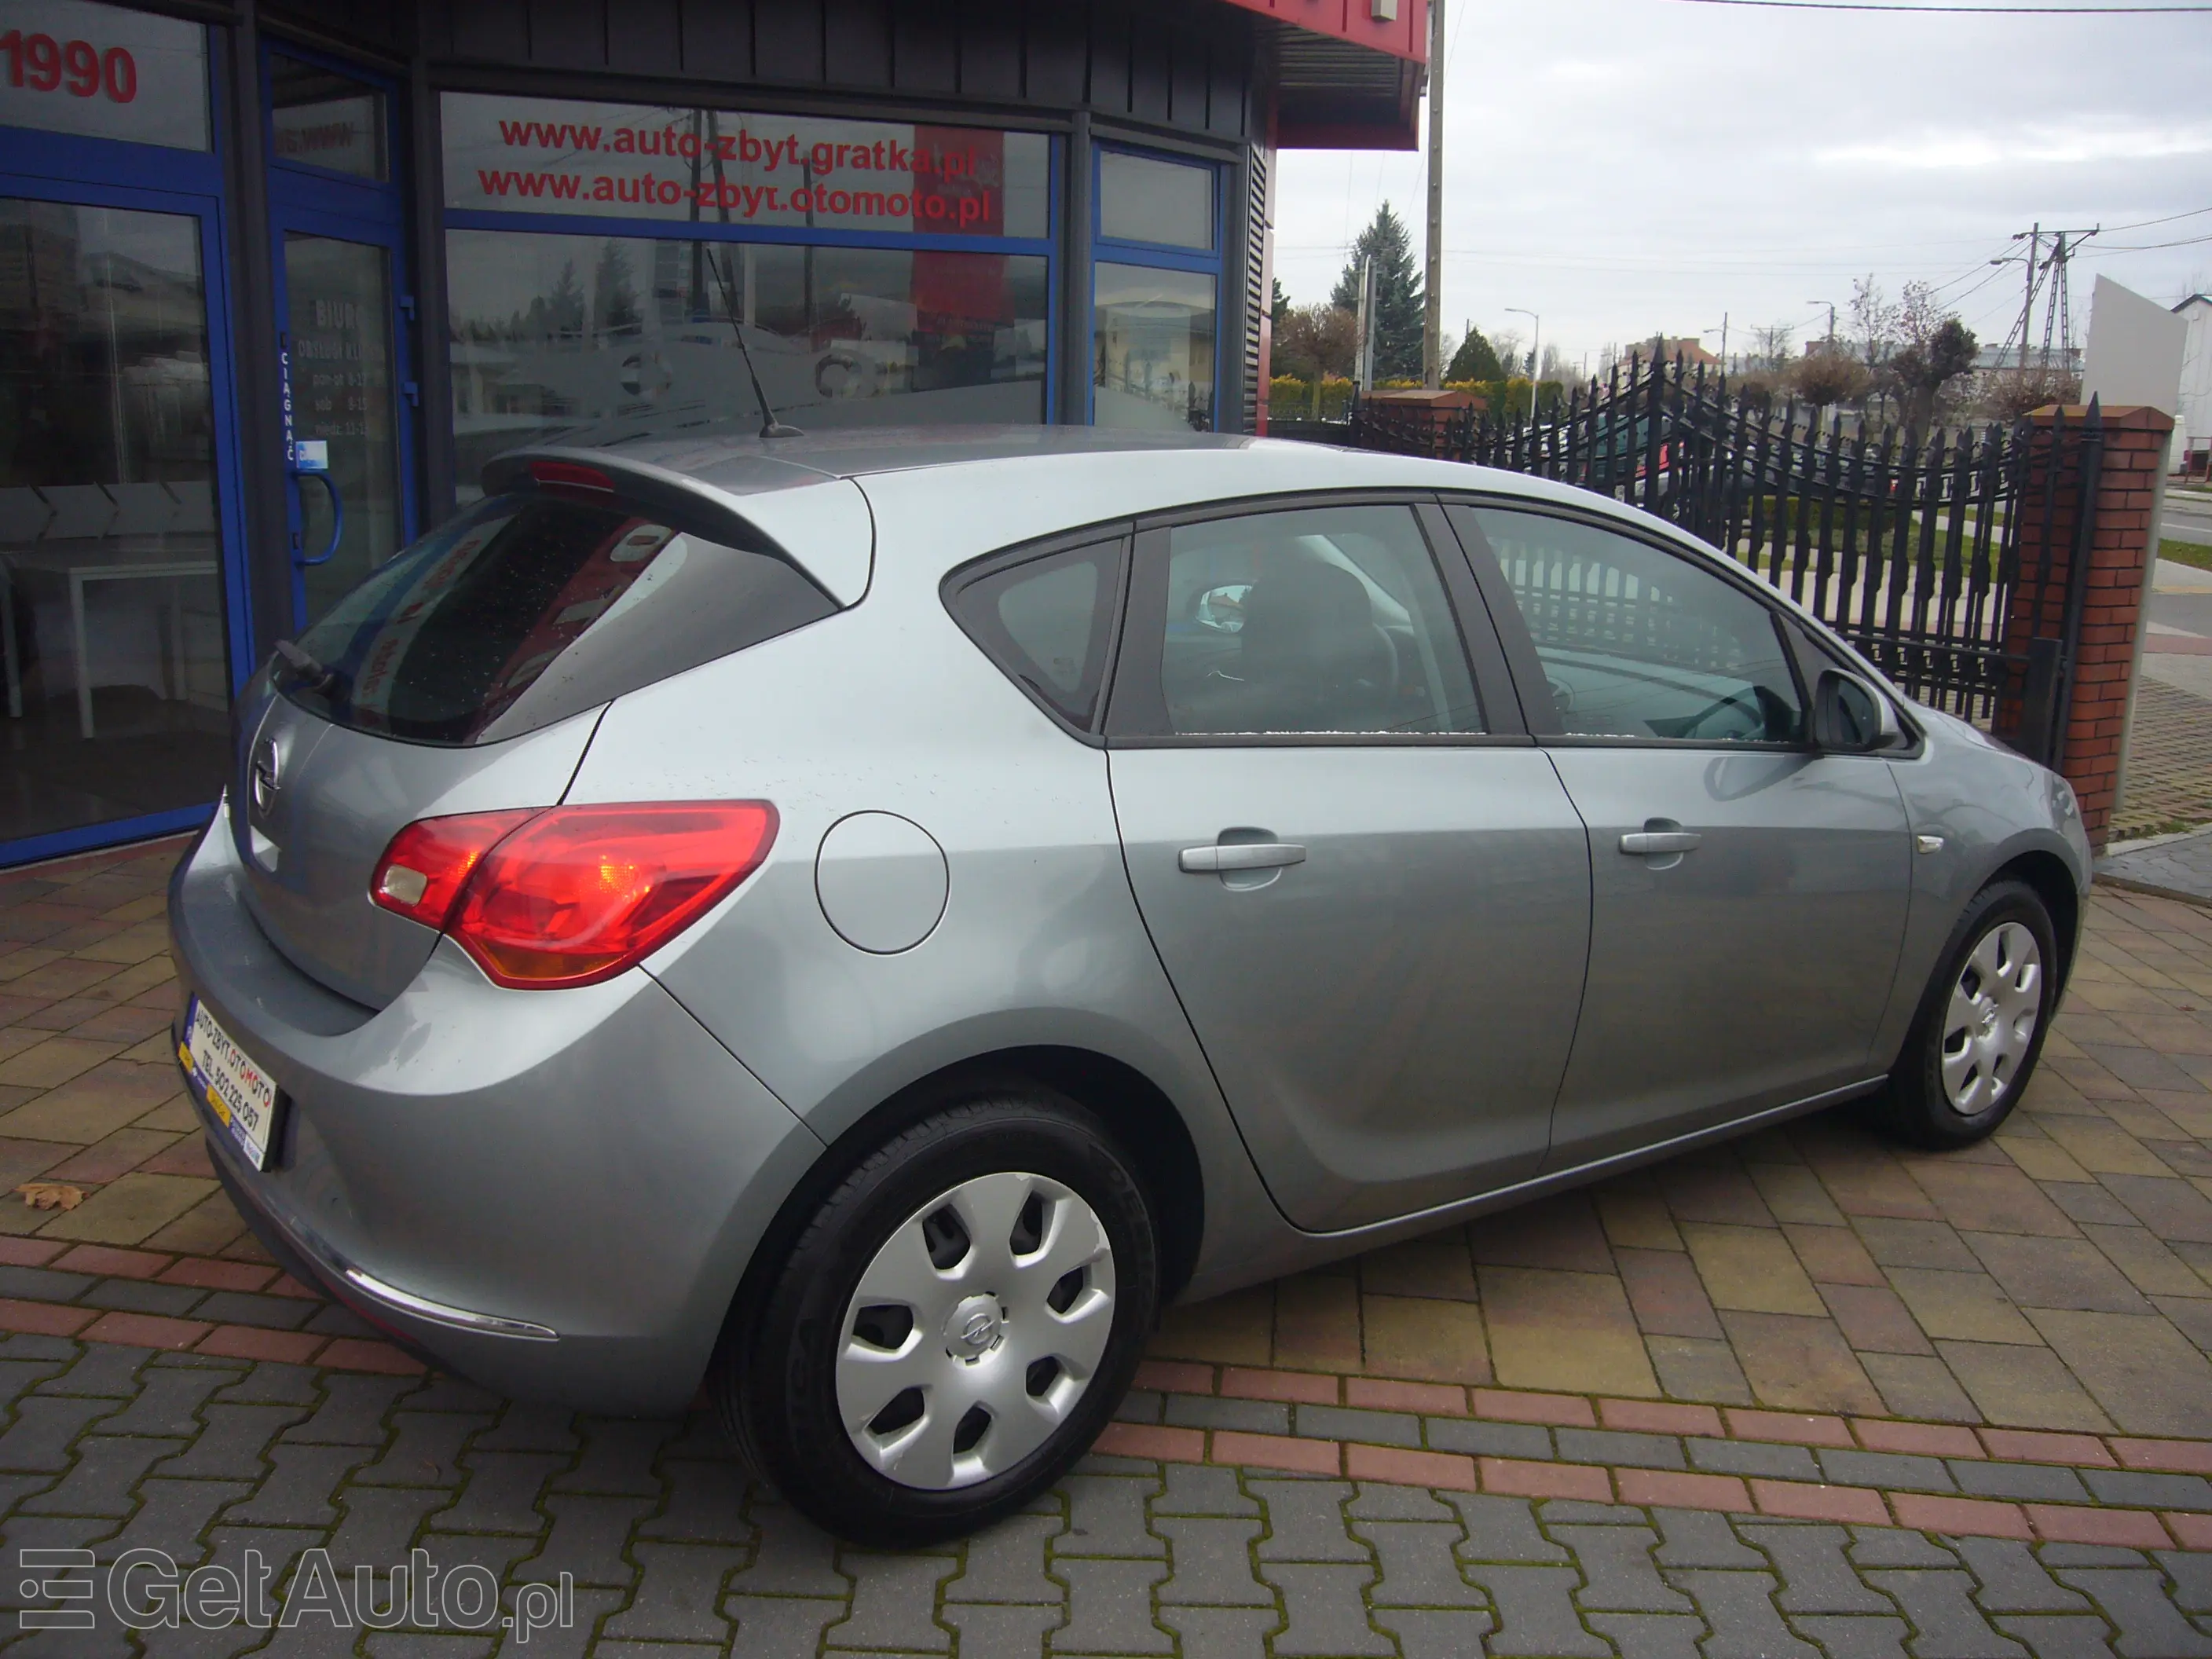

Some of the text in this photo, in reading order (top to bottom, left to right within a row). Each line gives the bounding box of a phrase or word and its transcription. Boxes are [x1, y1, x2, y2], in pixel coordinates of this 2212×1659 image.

[0, 29, 137, 104] 1990
[498, 119, 976, 183] www.auto-zbyt.gratka.pl
[478, 169, 991, 229] www.auto-zbyt.otomoto.pl
[214, 1068, 230, 1100] 502
[229, 1084, 244, 1115] 225
[242, 1101, 260, 1132] 057
